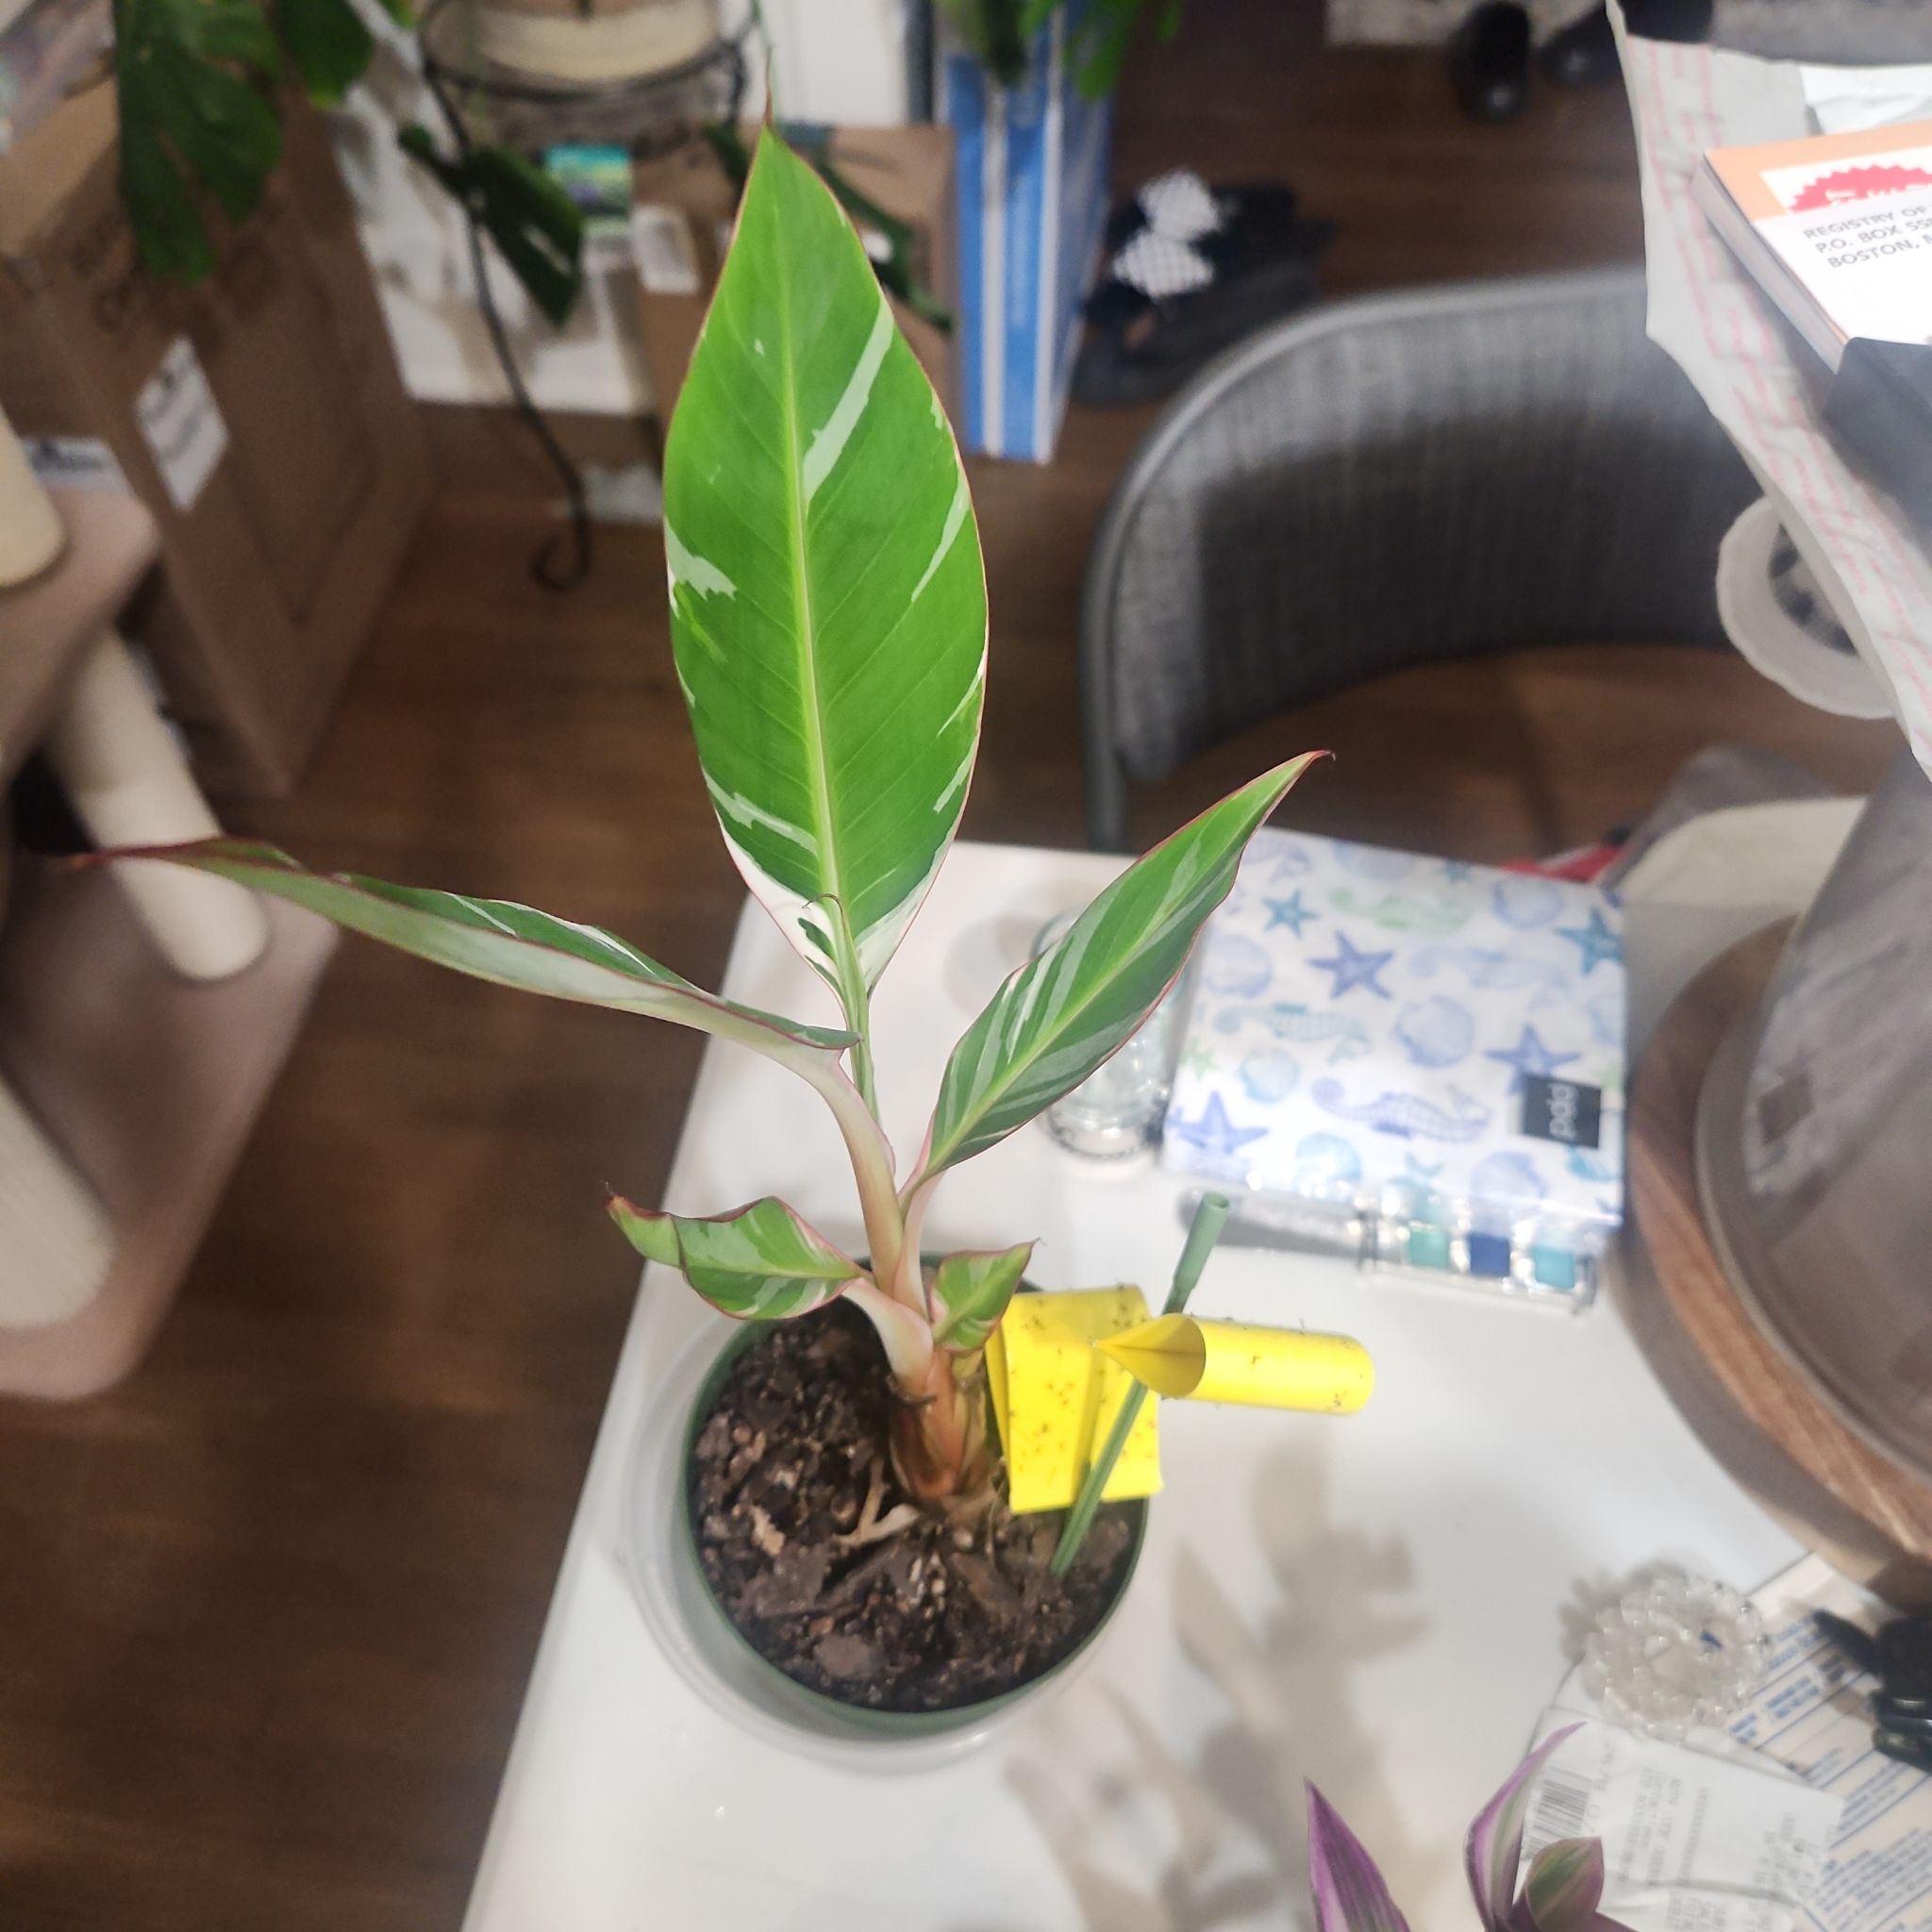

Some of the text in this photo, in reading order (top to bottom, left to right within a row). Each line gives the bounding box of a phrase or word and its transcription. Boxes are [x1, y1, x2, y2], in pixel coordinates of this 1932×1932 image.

[1803, 205, 1926, 240] REGISTRY OF
[1815, 238, 1855, 254] P.O.
[1857, 225, 1903, 243] BOX
[1826, 239, 1920, 268] BOSTON,
